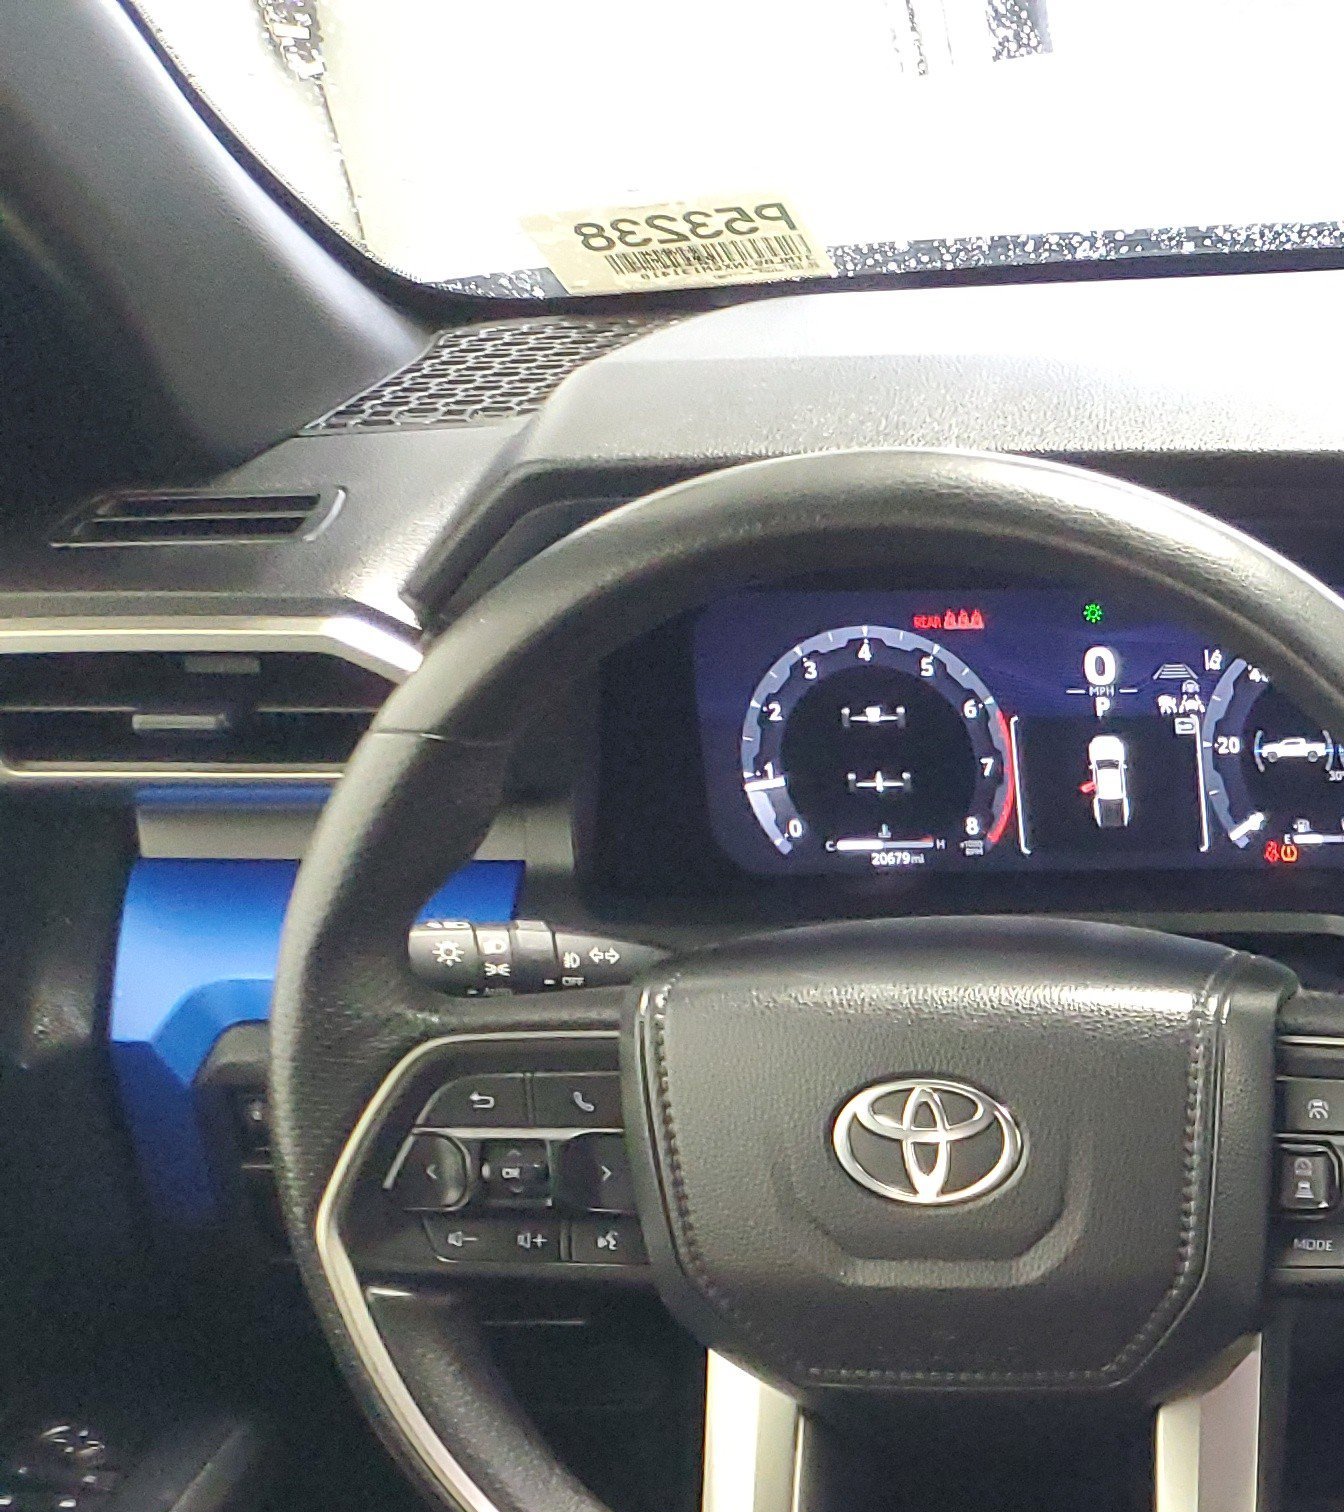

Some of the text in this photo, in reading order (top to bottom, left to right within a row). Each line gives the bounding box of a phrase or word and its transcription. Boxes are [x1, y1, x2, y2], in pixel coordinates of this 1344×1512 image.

[857, 640, 872, 662] 4
[803, 660, 818, 680] 3
[919, 657, 935, 677] 5
[1084, 646, 1116, 686] 0
[1089, 685, 1115, 697] MPH
[767, 702, 783, 721] 2
[962, 700, 977, 719] 6
[1094, 696, 1111, 717] P
[1218, 737, 1241, 754] 20
[764, 761, 775, 779] 1
[980, 757, 995, 776] 7
[788, 818, 803, 838] 0
[965, 816, 979, 835] 8
[825, 840, 836, 852] C
[936, 838, 946, 850] H
[1284, 834, 1292, 844] E
[1293, 1238, 1333, 1251] MODE
